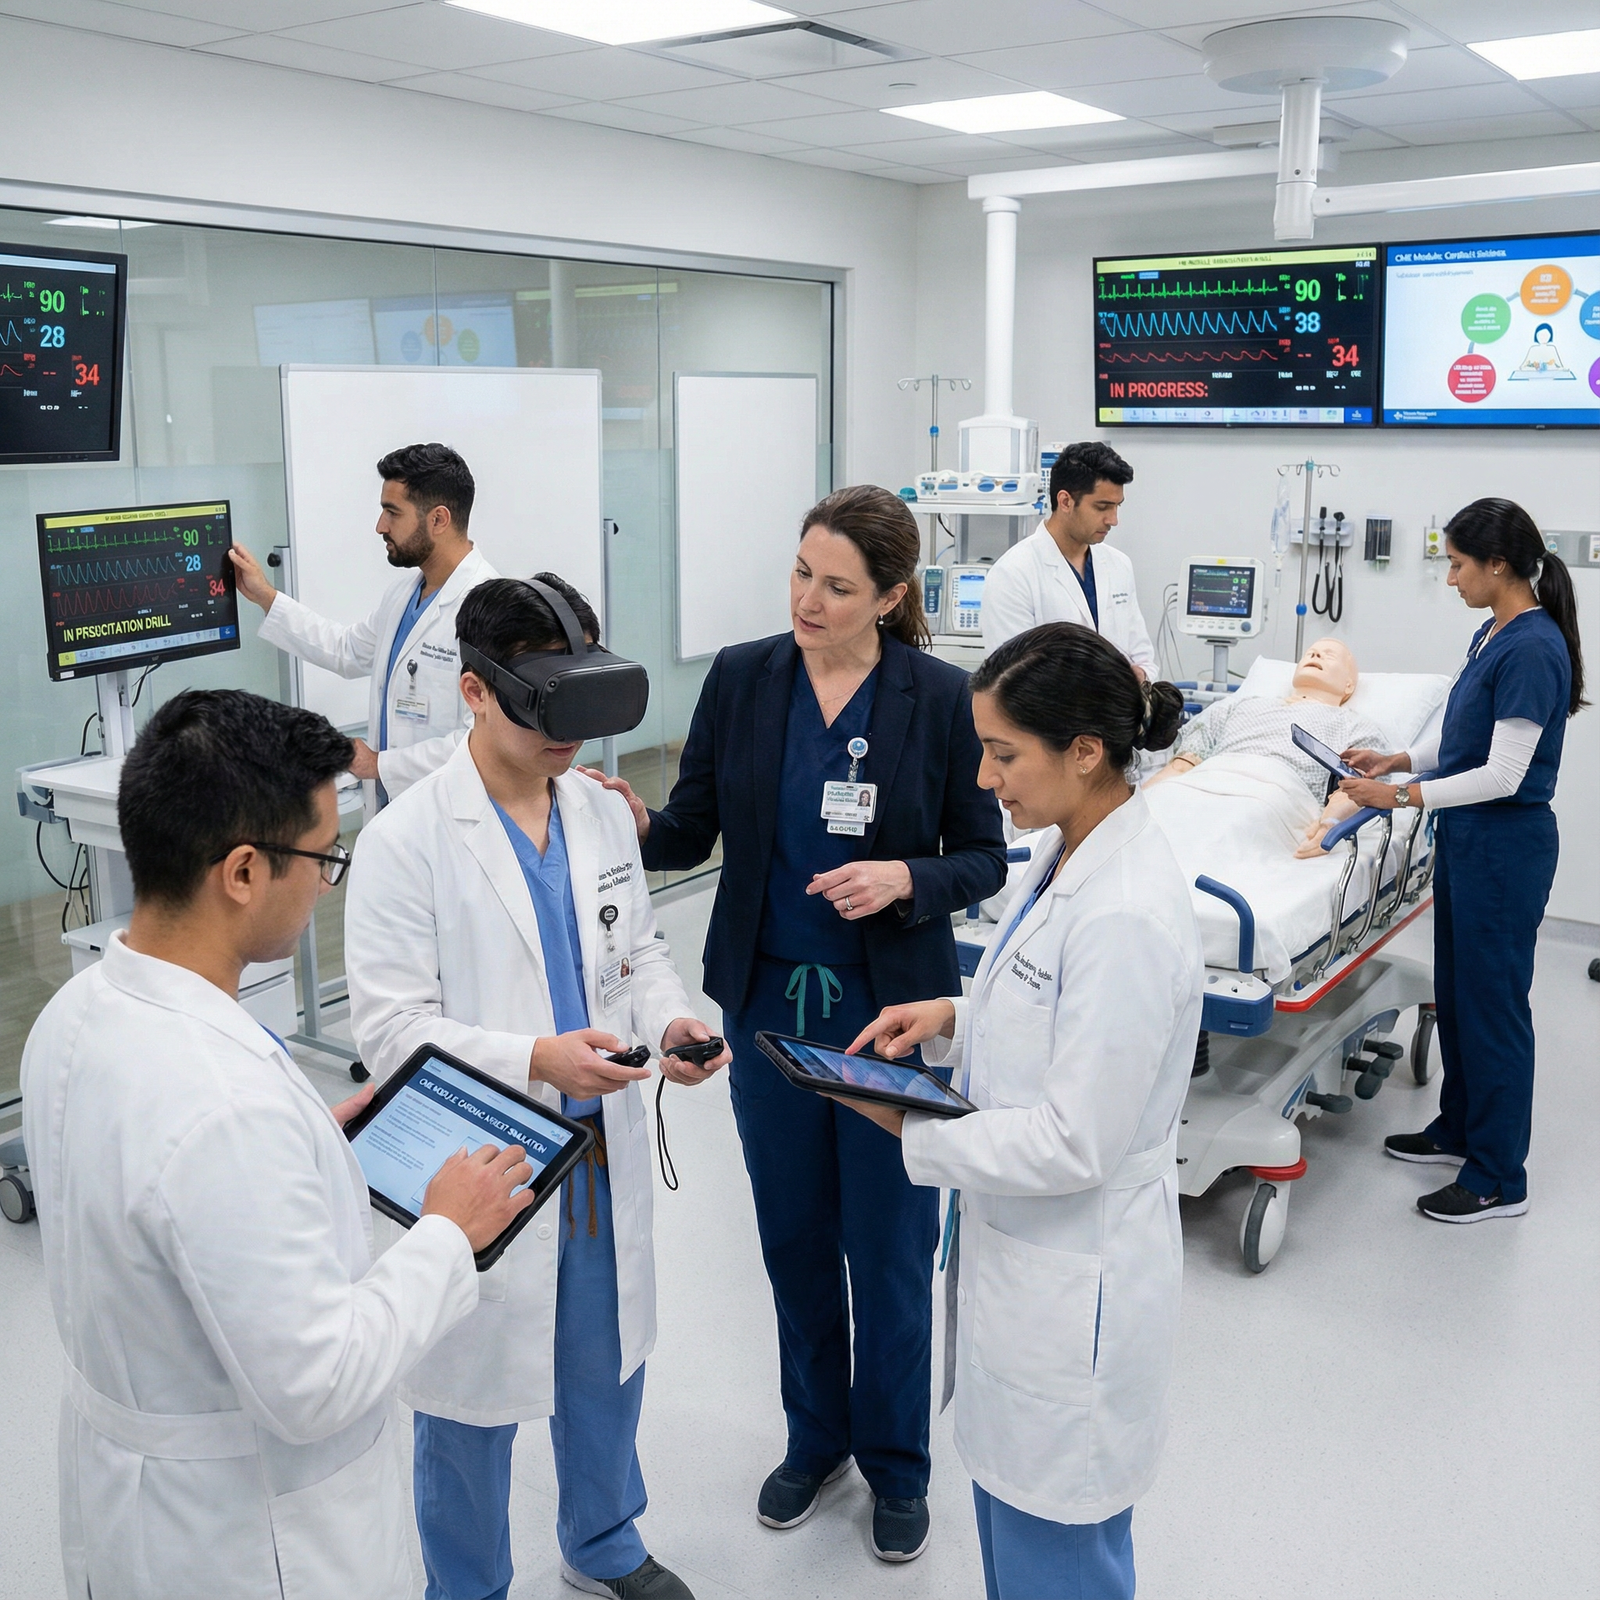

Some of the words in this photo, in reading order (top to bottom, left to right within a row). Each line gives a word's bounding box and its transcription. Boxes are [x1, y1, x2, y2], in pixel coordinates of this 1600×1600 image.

[39, 289, 66, 313] 90
[1294, 279, 1321, 302] 90
[1294, 311, 1321, 334] 38
[39, 324, 66, 348] 28
[1332, 344, 1360, 367] 34
[74, 363, 100, 386] 34
[1109, 382, 1124, 398] IN
[1128, 381, 1209, 398] PROGRESS:
[183, 528, 199, 547] 90
[185, 554, 202, 572] 28
[209, 578, 226, 597] 34
[63, 628, 75, 643] IN
[145, 614, 172, 629] DRILL
